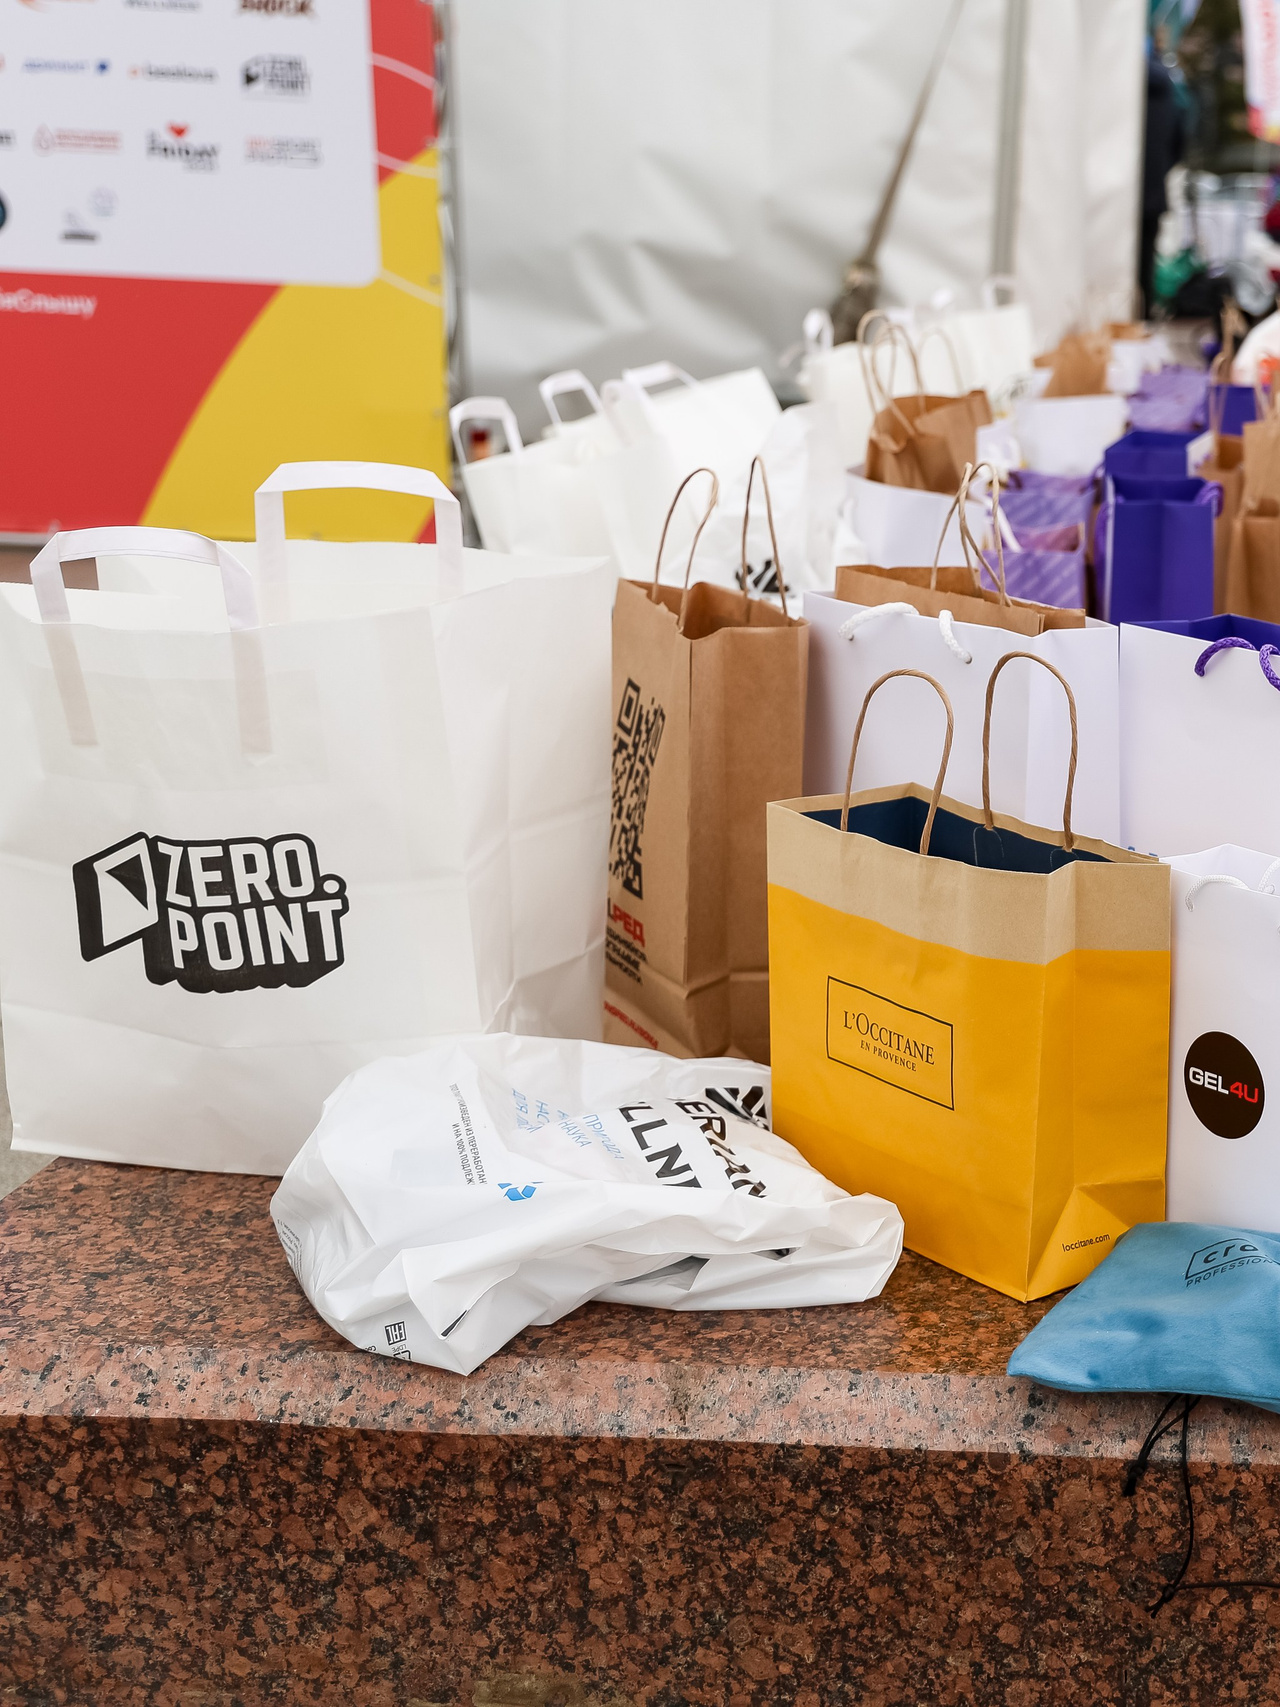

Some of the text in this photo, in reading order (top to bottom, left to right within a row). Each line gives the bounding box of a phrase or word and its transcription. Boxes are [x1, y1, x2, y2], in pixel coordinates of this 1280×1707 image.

[167, 898, 342, 971] POINT
[860, 1040, 917, 1072] EN PROVENCE
[1189, 1066, 1259, 1103] GEL4U
[453, 1129, 461, 1139] НА
[455, 1138, 467, 1155] 100%
[465, 1130, 475, 1141] ИЗ
[559, 1120, 592, 1148] НАУКА
[459, 1154, 475, 1186] ПОДЛЕЖ
[469, 1135, 488, 1185] ПЕРЕРАБОТАН
[1062, 1233, 1110, 1252] loccitane.com
